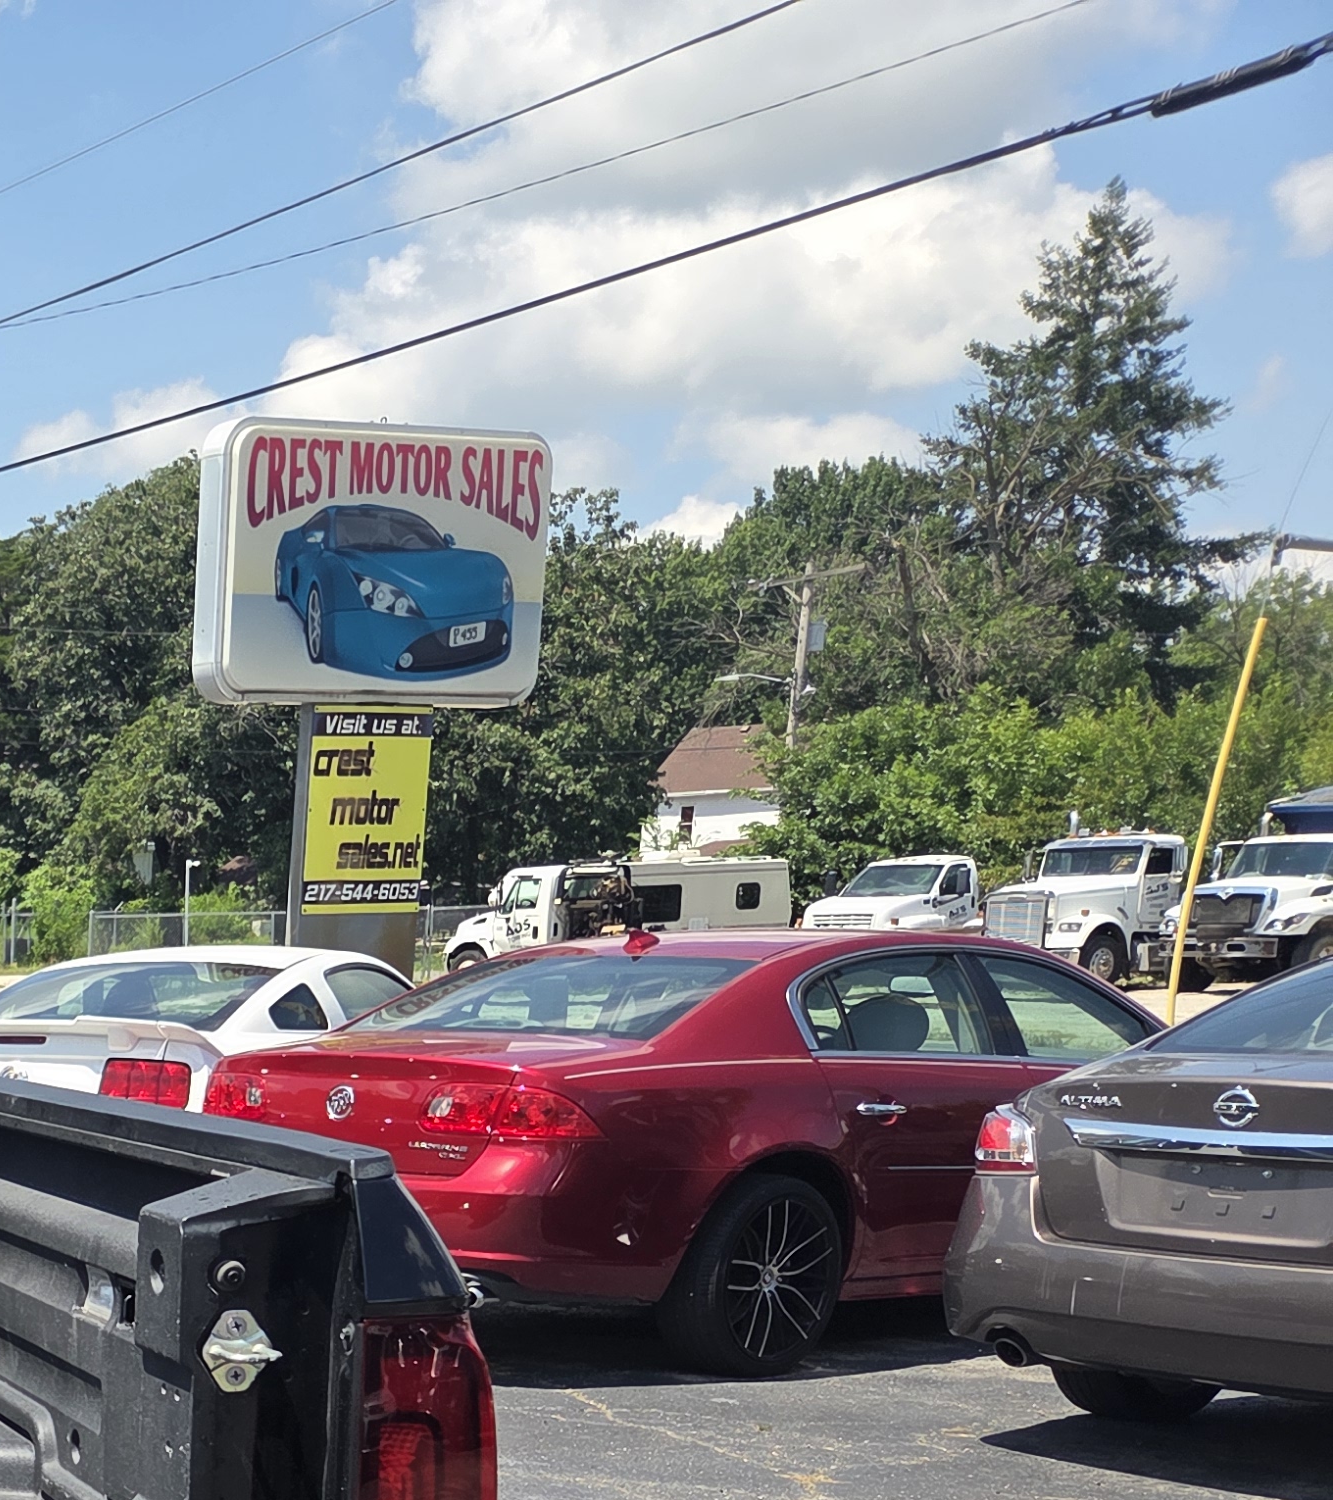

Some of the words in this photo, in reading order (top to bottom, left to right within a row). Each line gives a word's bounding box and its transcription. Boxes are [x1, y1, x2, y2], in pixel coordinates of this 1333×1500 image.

[247, 436, 343, 528] CREST
[350, 441, 452, 500] MOTOR
[460, 446, 544, 541] SALES
[326, 715, 367, 734] Visit
[372, 719, 397, 734] us
[313, 741, 375, 776] crest
[329, 790, 400, 825] motor
[336, 834, 421, 869] sales.net
[304, 883, 419, 901] 217-544-6053
[1060, 1094, 1122, 1107] ALTIMA
